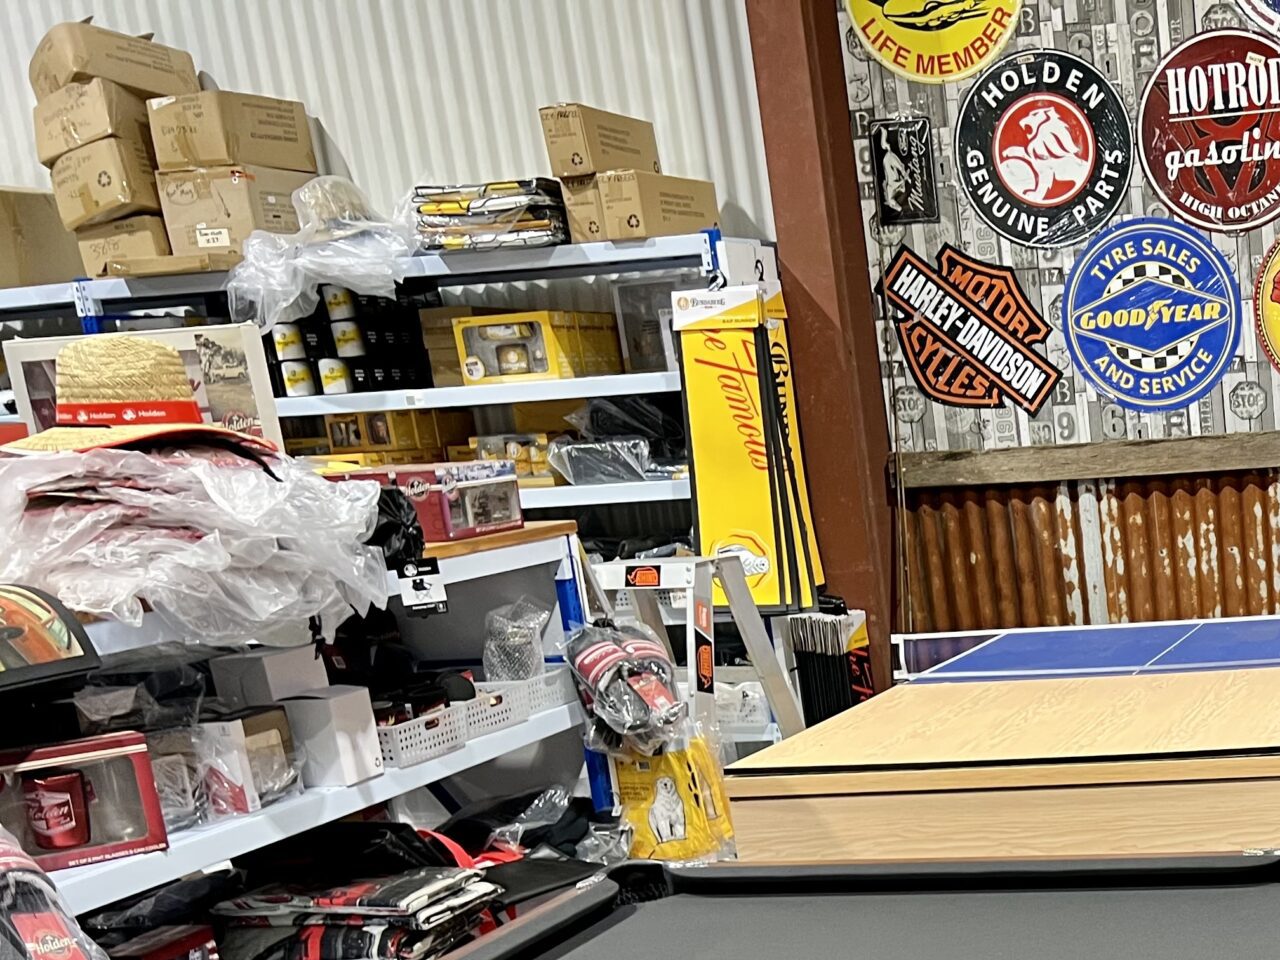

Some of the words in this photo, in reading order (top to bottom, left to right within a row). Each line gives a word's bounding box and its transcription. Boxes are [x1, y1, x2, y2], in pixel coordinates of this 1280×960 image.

[861, 17, 911, 69] LIFE
[916, 7, 1013, 75] MEMBER
[981, 61, 1105, 110] HOLDEN
[908, 124, 927, 212] Mustang
[966, 150, 1049, 236] GENUINE
[1073, 149, 1123, 226] PARTS
[1179, 191, 1223, 219] HIGH
[1090, 241, 1138, 281] TYRE
[1141, 238, 1201, 274] SALES
[949, 264, 1031, 339] MOTOR
[892, 264, 1047, 400] HARLEY-DAVIDSON
[910, 326, 990, 397] CYCLES
[1094, 355, 1135, 391] AND
[1139, 347, 1213, 395] SERVICE
[138, 409, 167, 418] Holden
[35, 937, 72, 956] Holden
